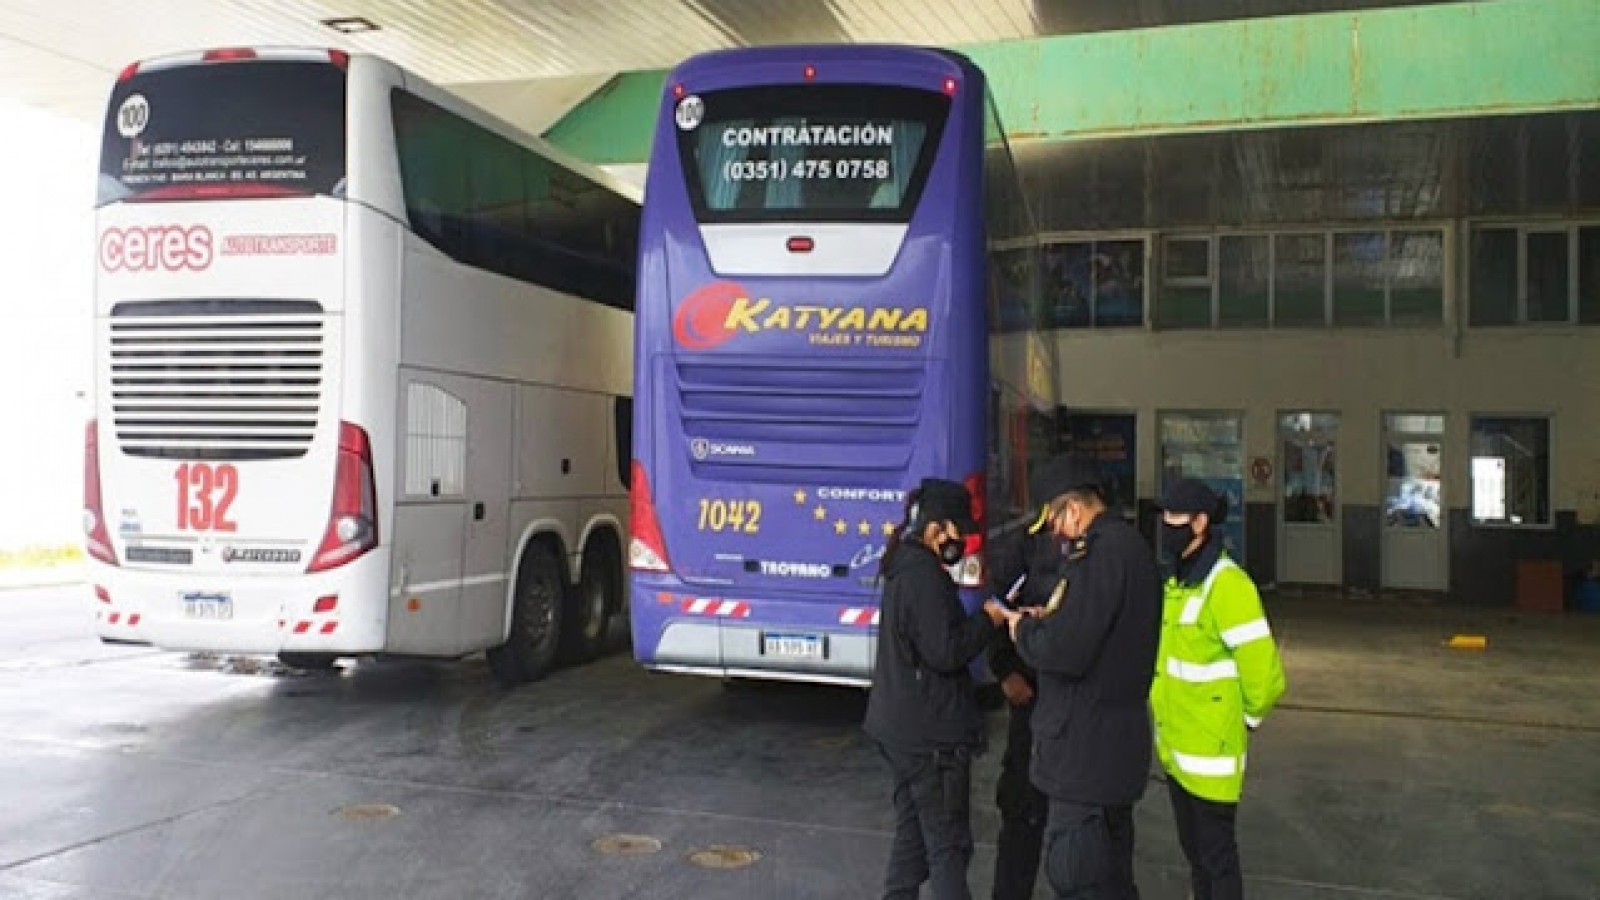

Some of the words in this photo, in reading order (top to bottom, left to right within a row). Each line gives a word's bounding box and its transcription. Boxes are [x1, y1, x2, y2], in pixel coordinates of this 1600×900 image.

[122, 103, 146, 129] 100
[724, 159, 786, 181] (0351)
[791, 160, 831, 179] 475
[835, 160, 889, 179] 0758
[100, 224, 213, 273] ceres
[219, 233, 337, 255] AUTOTRANSPORTE
[724, 297, 928, 331] KATYANA
[808, 333, 850, 345] VIAJES
[854, 334, 862, 345] Y
[865, 334, 921, 346] TURISMO
[175, 463, 238, 532] 132
[816, 486, 906, 502] CONFORT
[698, 498, 761, 534] 1042
[759, 560, 831, 578] TROYANO
